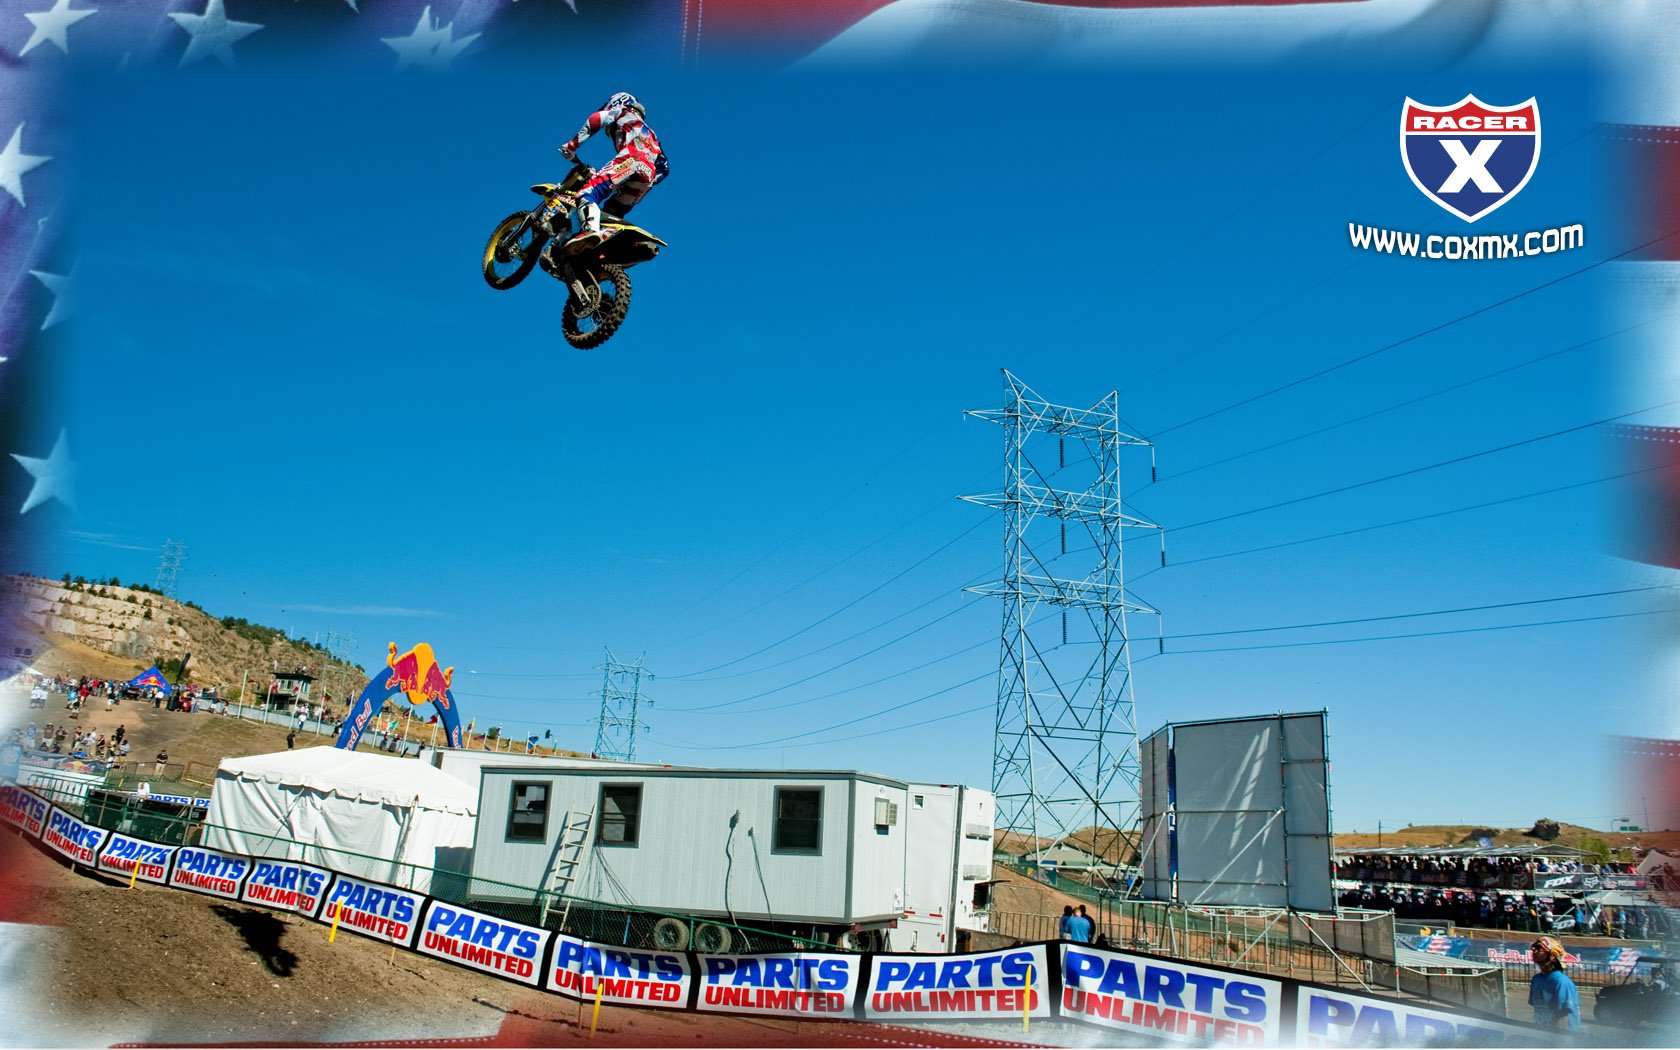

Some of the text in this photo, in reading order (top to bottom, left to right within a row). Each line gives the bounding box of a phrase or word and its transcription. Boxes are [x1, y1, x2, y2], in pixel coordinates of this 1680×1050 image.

[0, 786, 46, 821] PARTS
[46, 829, 94, 863] UNLIMITED
[50, 811, 102, 849] PARTS
[101, 855, 164, 879] UNLIMTED
[106, 837, 172, 865] PARTS
[177, 849, 247, 880] PARTS
[174, 870, 237, 895] UNLIMITED
[250, 863, 326, 897] PARTS
[1544, 875, 1575, 888] FOX
[247, 884, 316, 912] UNLIMITED
[330, 880, 416, 923] PARTS
[326, 902, 409, 941] UNLIMITED
[427, 905, 542, 959] PARTS
[424, 932, 534, 979] UNLIMITED
[557, 940, 685, 983] PARTS
[876, 952, 1038, 992] PARTS
[704, 957, 850, 991] PARTS
[1065, 950, 1268, 1023] PARTS
[704, 986, 845, 1013] UNLIMITED
[872, 988, 1039, 1013] UNLIMITED
[1062, 987, 1266, 1046] UNLIMITED
